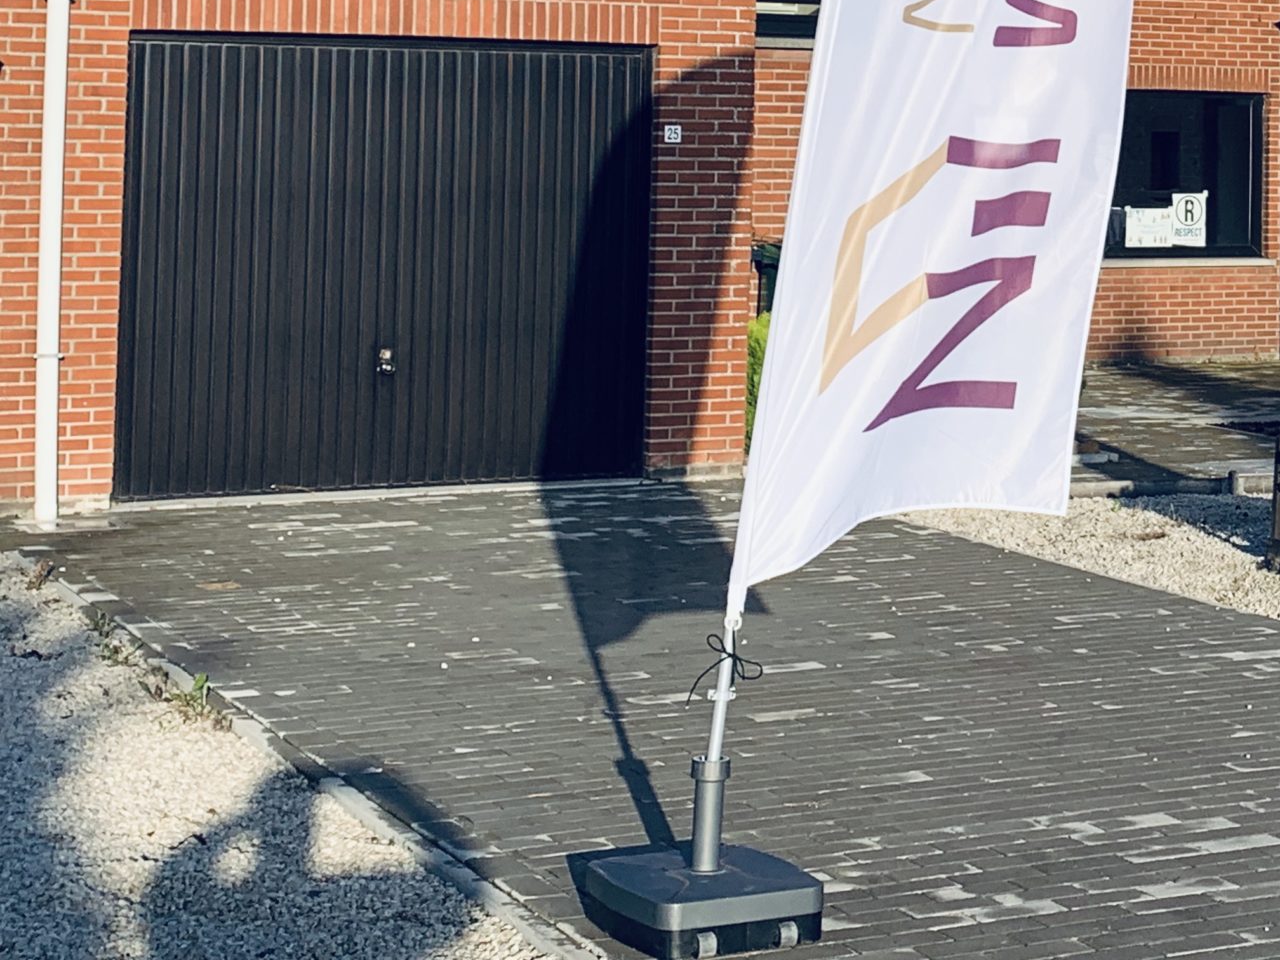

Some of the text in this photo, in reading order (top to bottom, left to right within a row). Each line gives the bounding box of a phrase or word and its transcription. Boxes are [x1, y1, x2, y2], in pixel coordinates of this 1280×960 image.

[667, 127, 679, 140] 25
[1184, 199, 1195, 223] R
[1174, 227, 1203, 238] RESPECT
